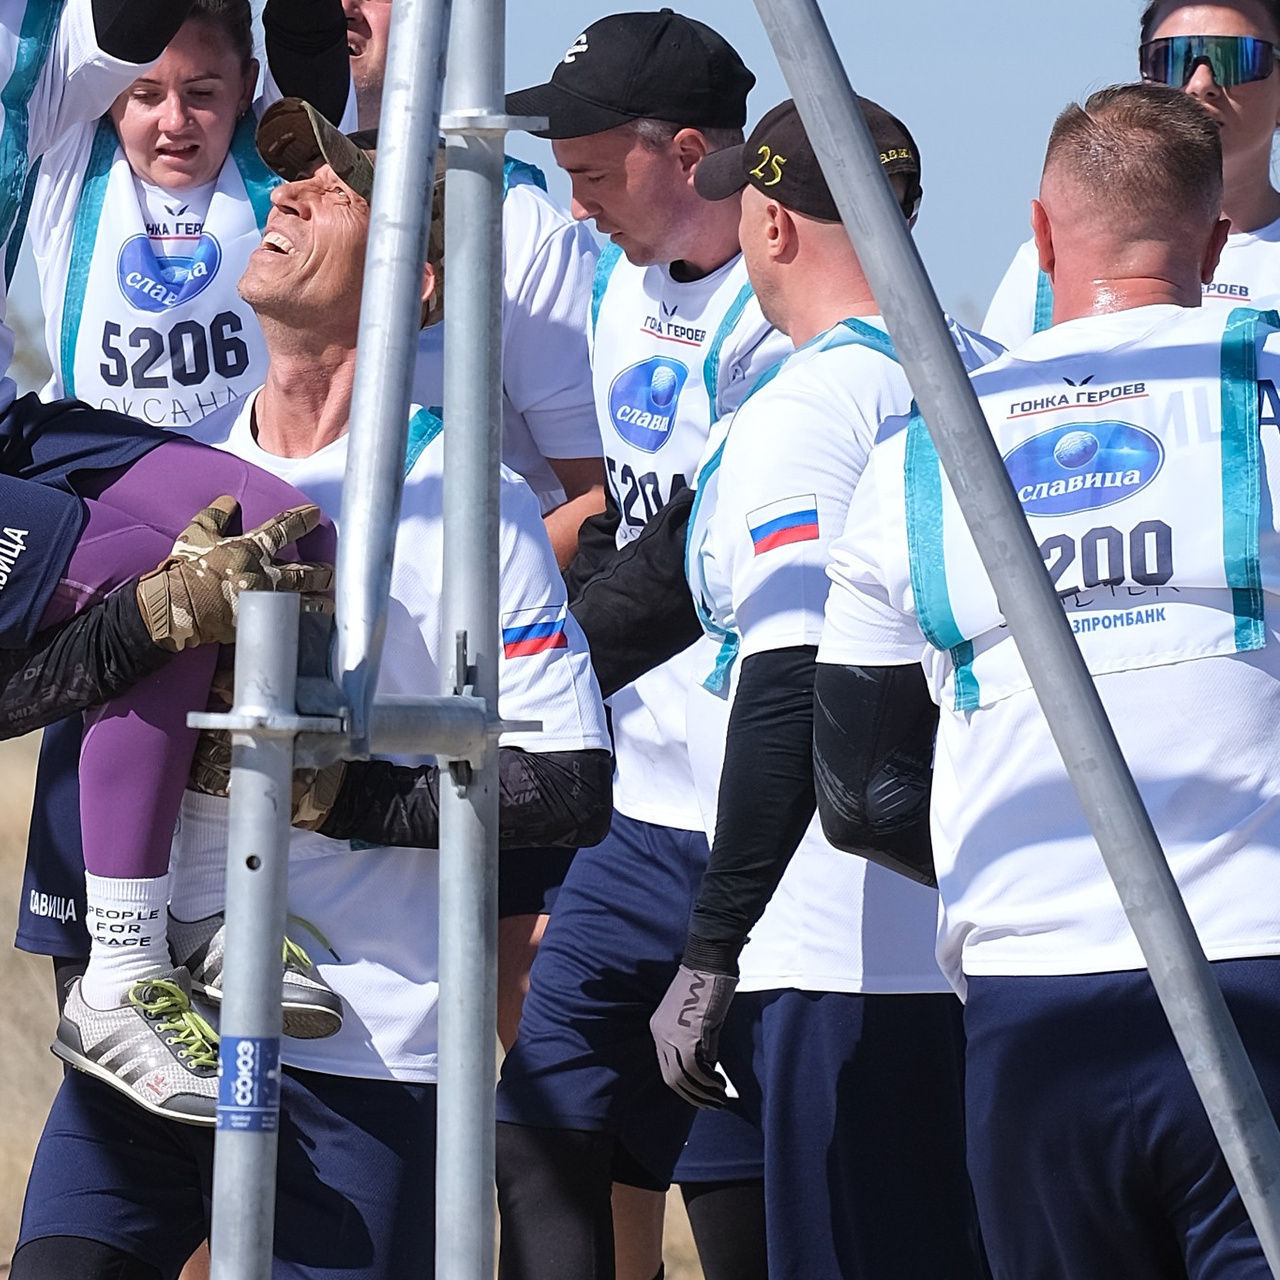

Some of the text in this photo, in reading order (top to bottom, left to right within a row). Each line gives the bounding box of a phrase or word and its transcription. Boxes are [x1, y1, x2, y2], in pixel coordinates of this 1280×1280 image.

[749, 145, 787, 186] 25
[100, 311, 250, 389] 5206
[1010, 383, 1146, 415] ГОНКА ГЕРОЕВ
[1018, 470, 1140, 503] славица
[88, 905, 160, 920] PEOPLE
[96, 922, 141, 934] FOR
